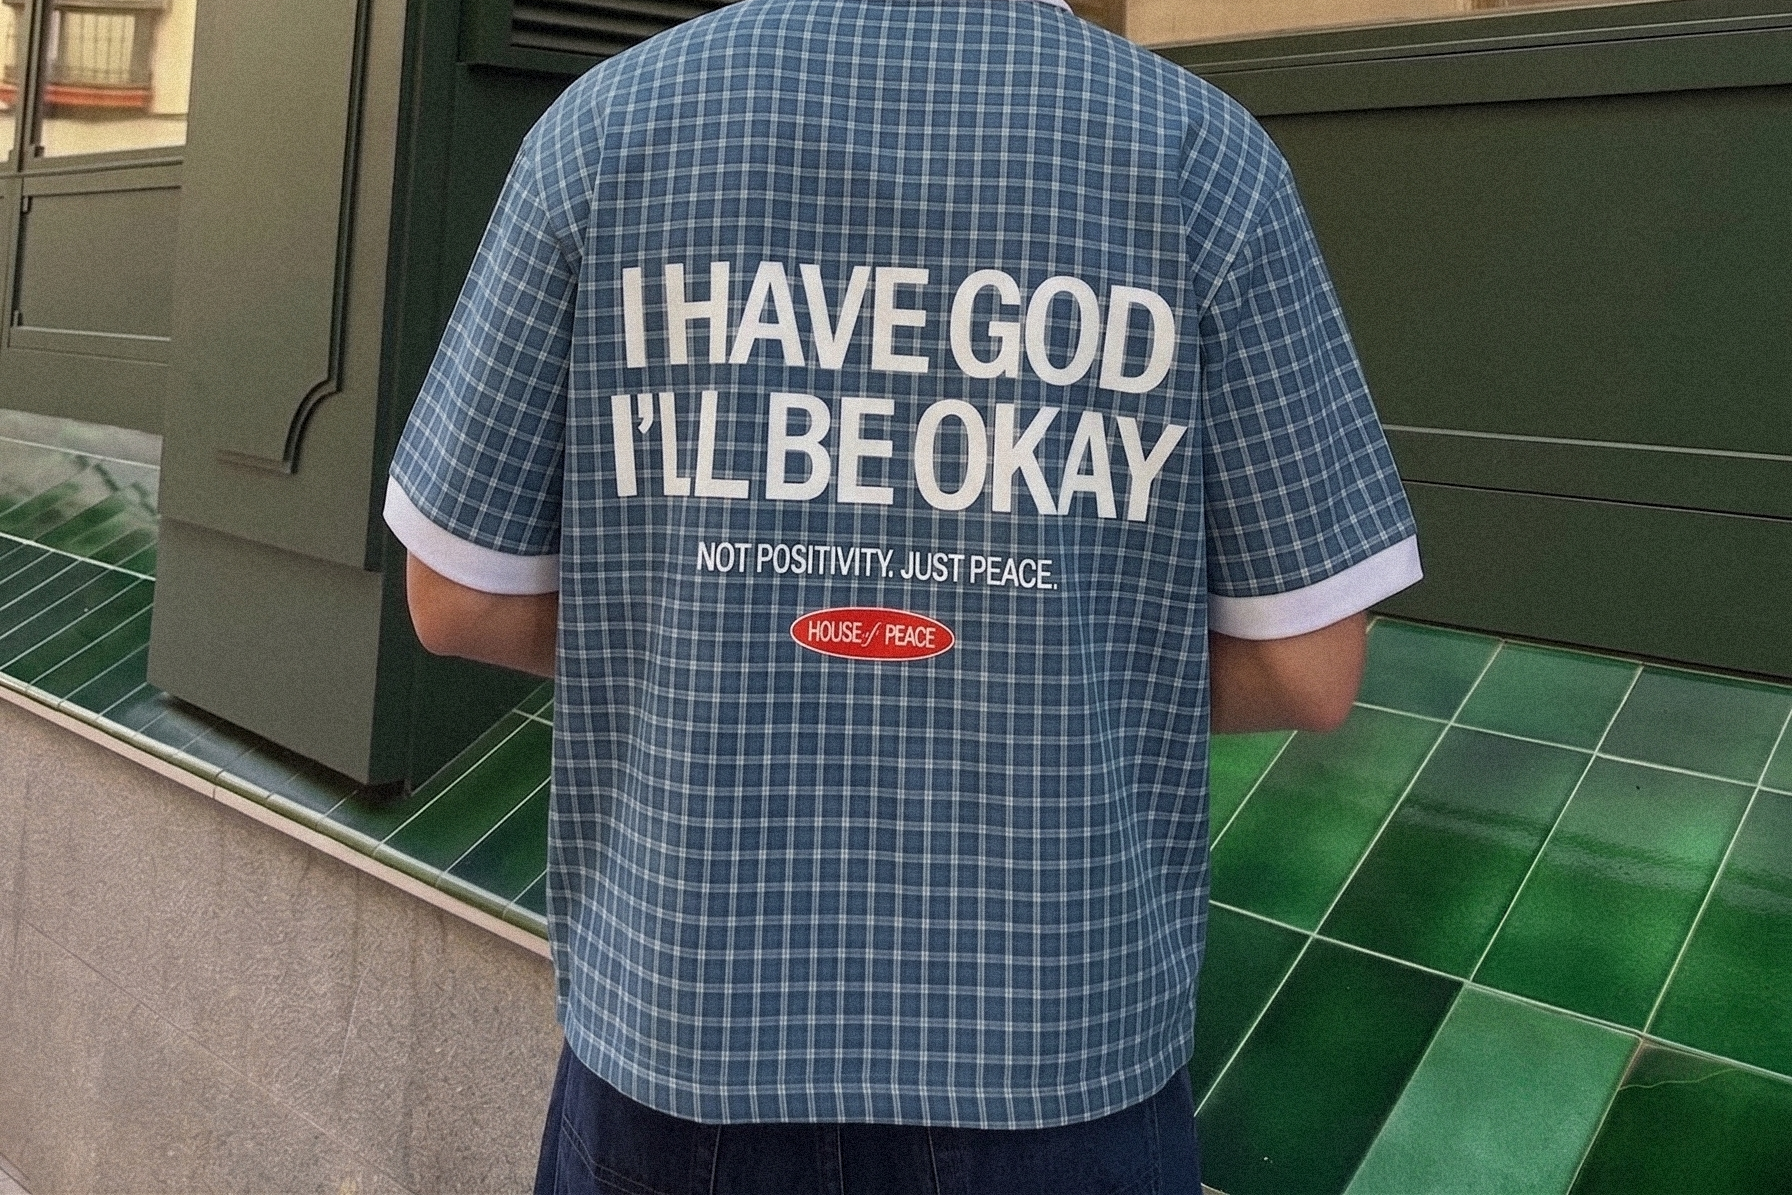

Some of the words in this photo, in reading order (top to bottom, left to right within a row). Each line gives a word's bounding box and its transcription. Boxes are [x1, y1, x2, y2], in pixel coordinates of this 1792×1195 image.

[622, 266, 646, 369] I
[664, 261, 930, 373] HAVE
[949, 268, 1176, 394] GOD
[610, 390, 750, 498] I'LL
[765, 391, 895, 505] BE
[914, 398, 1188, 523] OKAY
[696, 541, 752, 574] NOT
[756, 542, 894, 578] POSITIVITY.
[900, 551, 965, 582] JUST
[969, 554, 1059, 590] PEACE.
[807, 620, 863, 644] HOUSE
[885, 626, 936, 649] PEACE
